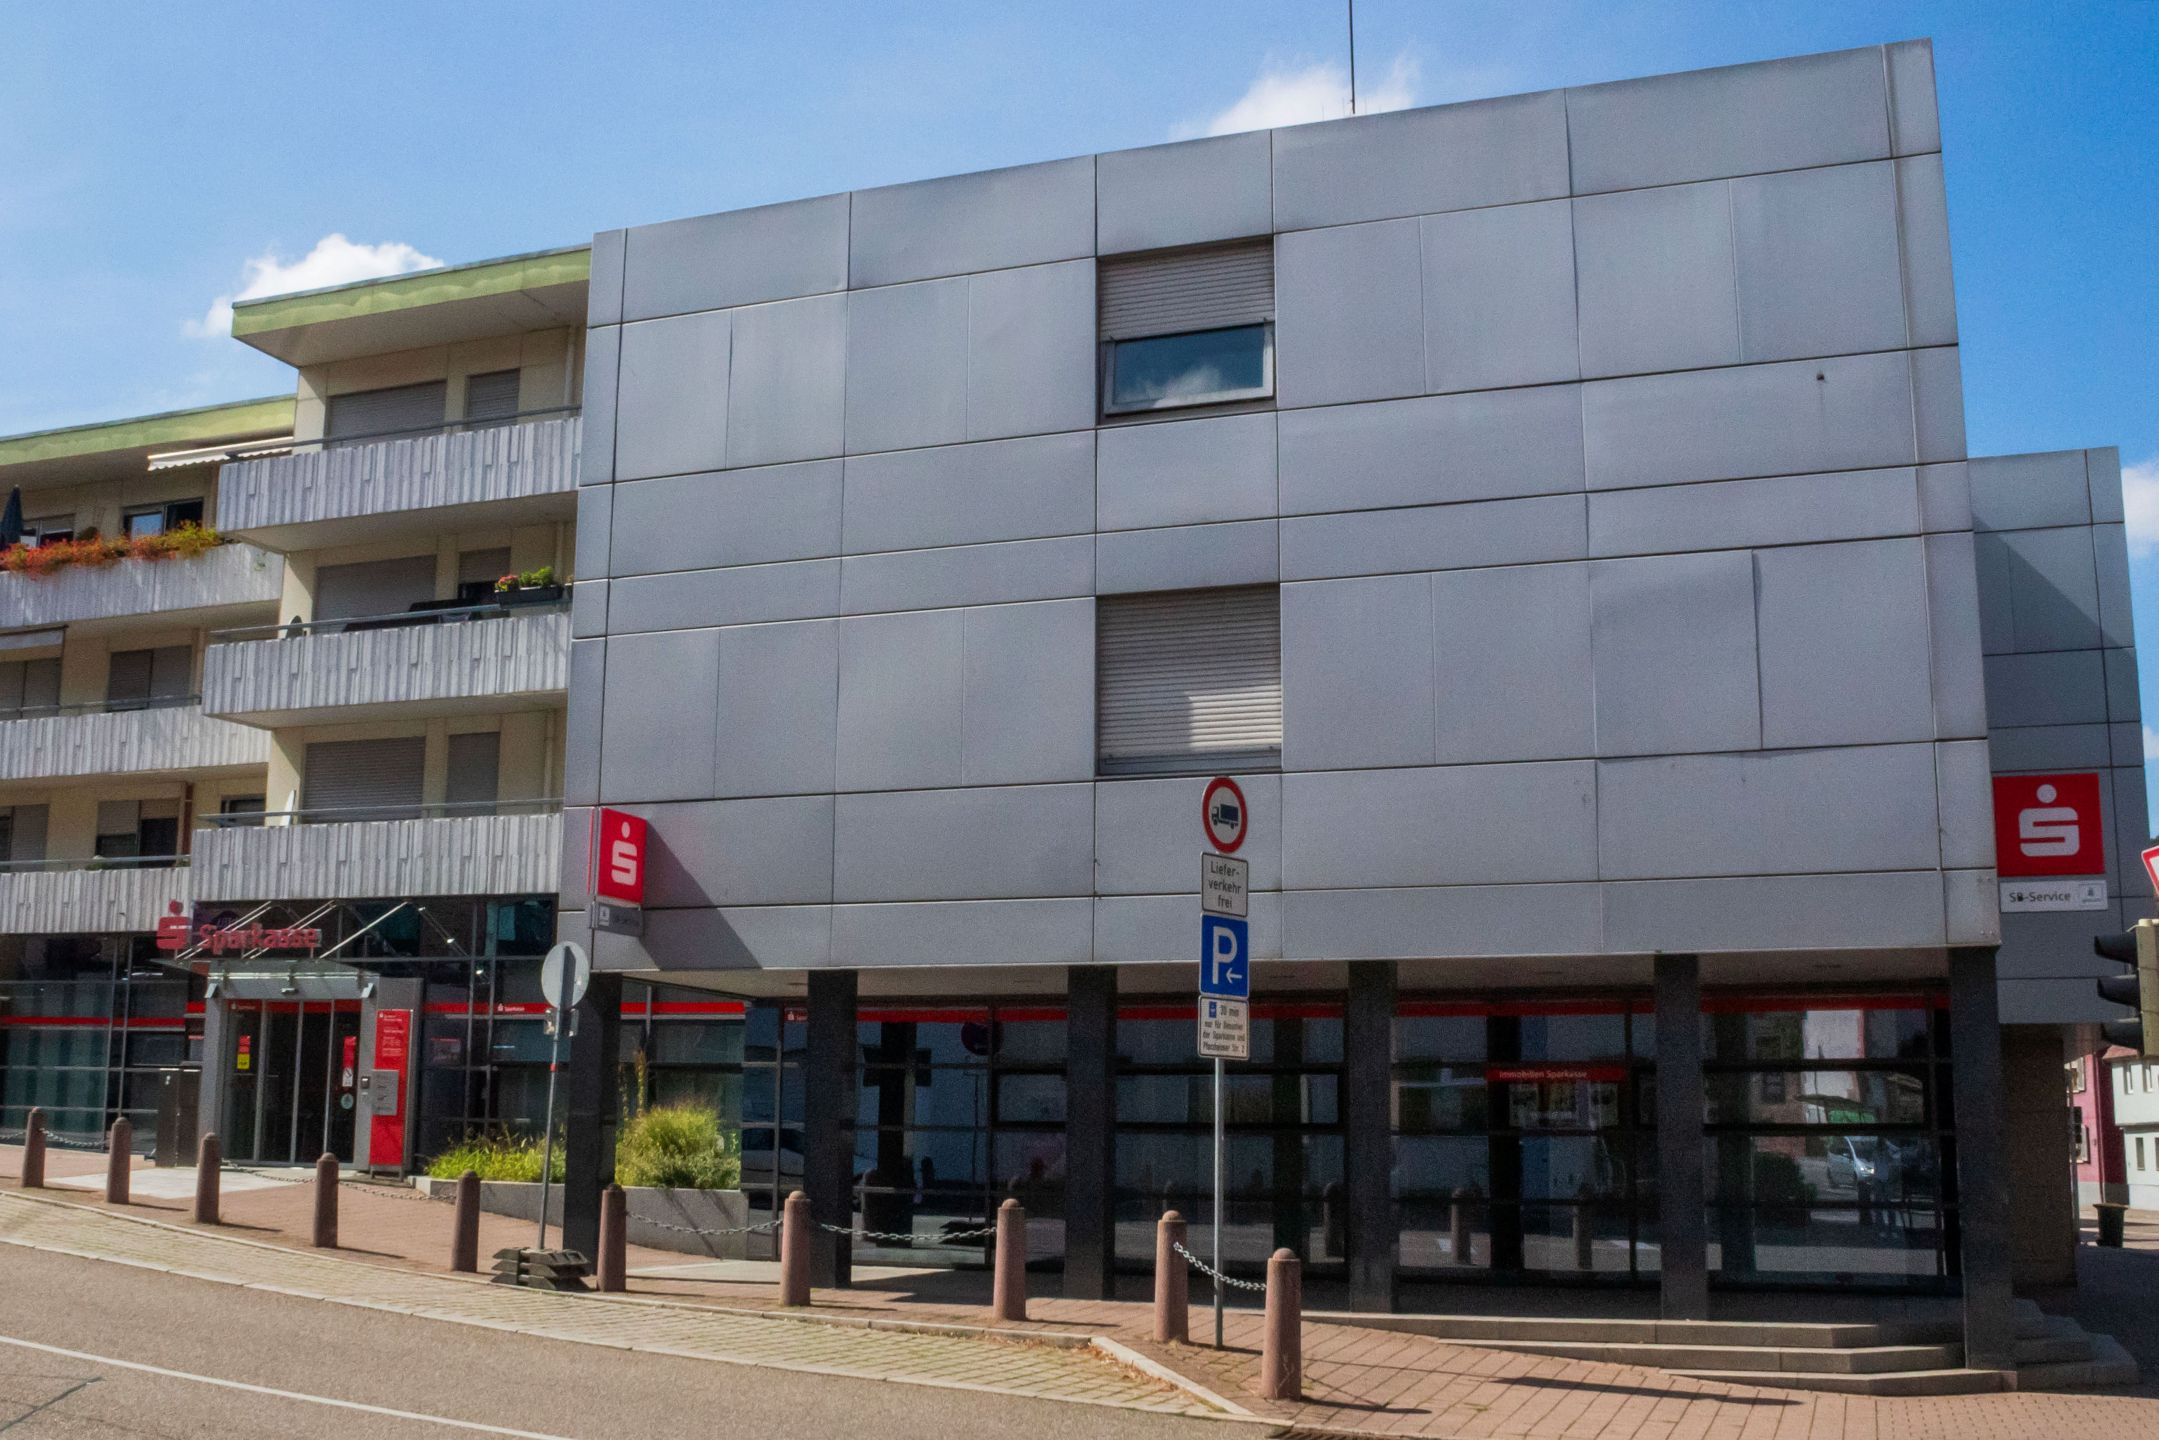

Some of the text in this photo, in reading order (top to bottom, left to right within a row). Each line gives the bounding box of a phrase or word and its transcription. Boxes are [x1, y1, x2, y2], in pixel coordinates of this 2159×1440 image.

[1210, 861, 1240, 876] Liefer-
[1208, 879, 1242, 895] verkehr
[1217, 895, 1232, 909] frei
[2009, 891, 2071, 903] SB-Service
[199, 922, 322, 955] Sparkasse
[1212, 926, 1238, 985] P
[1499, 1069, 1588, 1080] Immobilien Sparkasse
